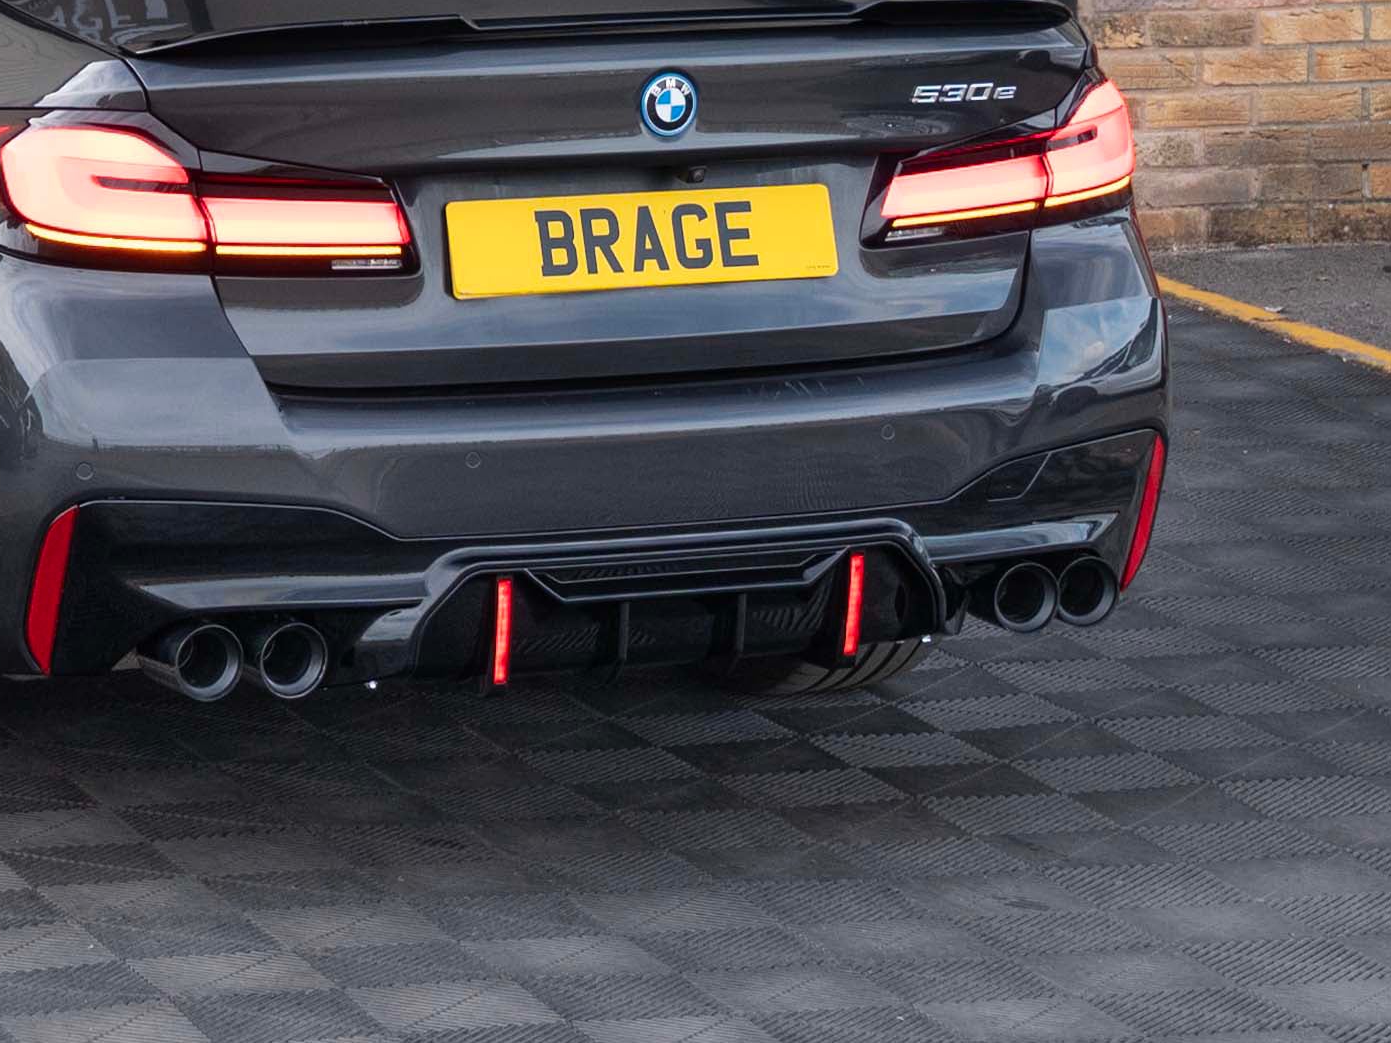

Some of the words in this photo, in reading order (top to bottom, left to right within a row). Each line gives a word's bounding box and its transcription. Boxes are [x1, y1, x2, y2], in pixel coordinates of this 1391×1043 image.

[650, 77, 691, 96] BMW
[910, 82, 1017, 103] 530e
[534, 201, 759, 276] BRAGE
